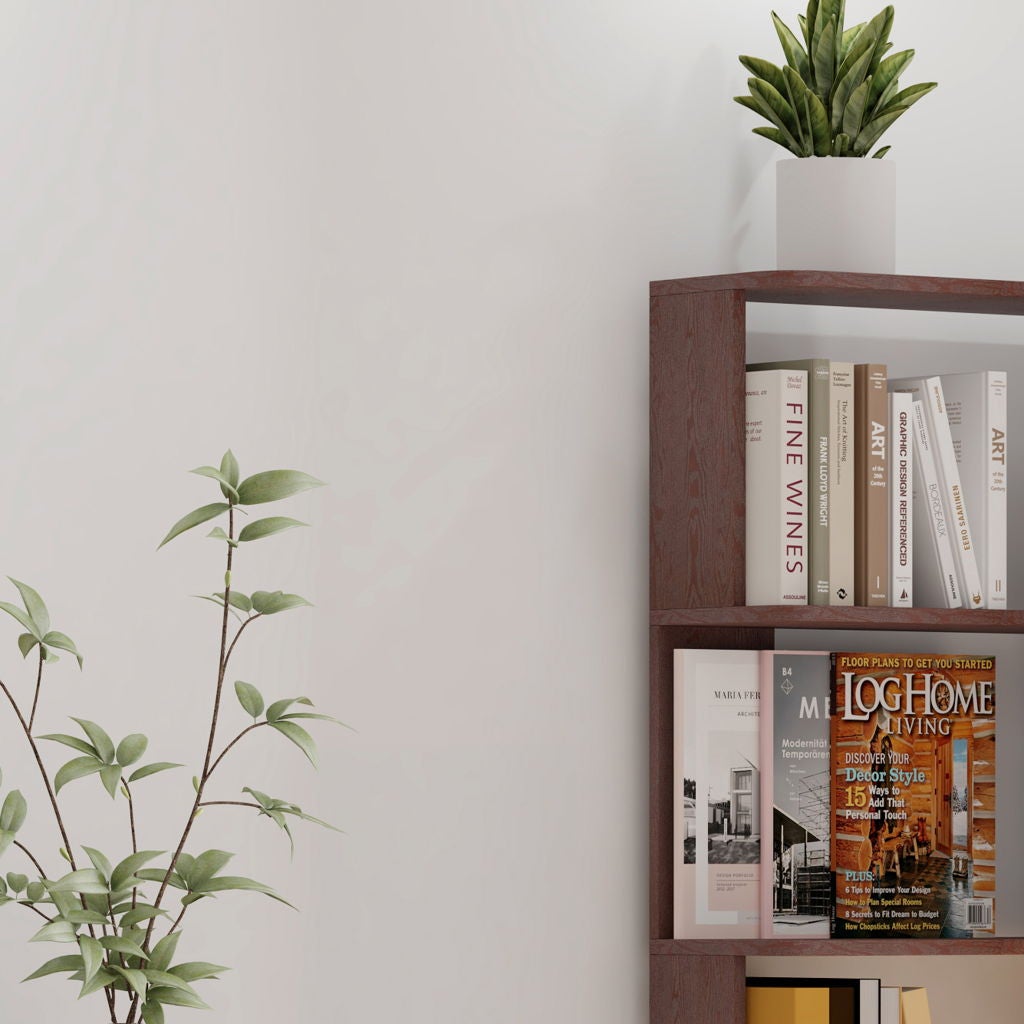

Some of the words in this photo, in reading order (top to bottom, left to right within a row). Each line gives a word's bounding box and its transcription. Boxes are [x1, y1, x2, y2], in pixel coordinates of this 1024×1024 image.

[787, 403, 802, 464] FINE
[871, 420, 885, 459] ART
[992, 427, 1004, 465] ART
[929, 483, 947, 537] BORDEAUX
[952, 485, 966, 527] SAARINEN
[786, 480, 803, 573] WINES
[960, 529, 970, 551] EERO
[841, 657, 869, 667] FLOOR
[872, 658, 900, 667] PLANS
[903, 658, 913, 668] TO
[916, 658, 933, 668] GET
[934, 659, 951, 669] YOU
[955, 659, 993, 670] STARTED
[714, 691, 741, 700] MARIA
[887, 717, 950, 735] LIVING
[845, 752, 885, 764] DISCOVER
[888, 753, 909, 764] YOUR
[889, 768, 926, 786] Style
[845, 786, 867, 807] 15
[869, 785, 889, 796] Ways
[892, 786, 900, 795] to
[869, 798, 884, 807] Add
[887, 798, 905, 807] That
[846, 810, 880, 819] Personal
[883, 810, 907, 819] Touch
[845, 872, 876, 881] PLUS:
[872, 887, 895, 895] Improve
[911, 887, 931, 895] Design
[880, 899, 901, 907] Special
[918, 911, 939, 919] Budget
[859, 923, 890, 931] Chopsticks
[910, 923, 922, 931] Log
